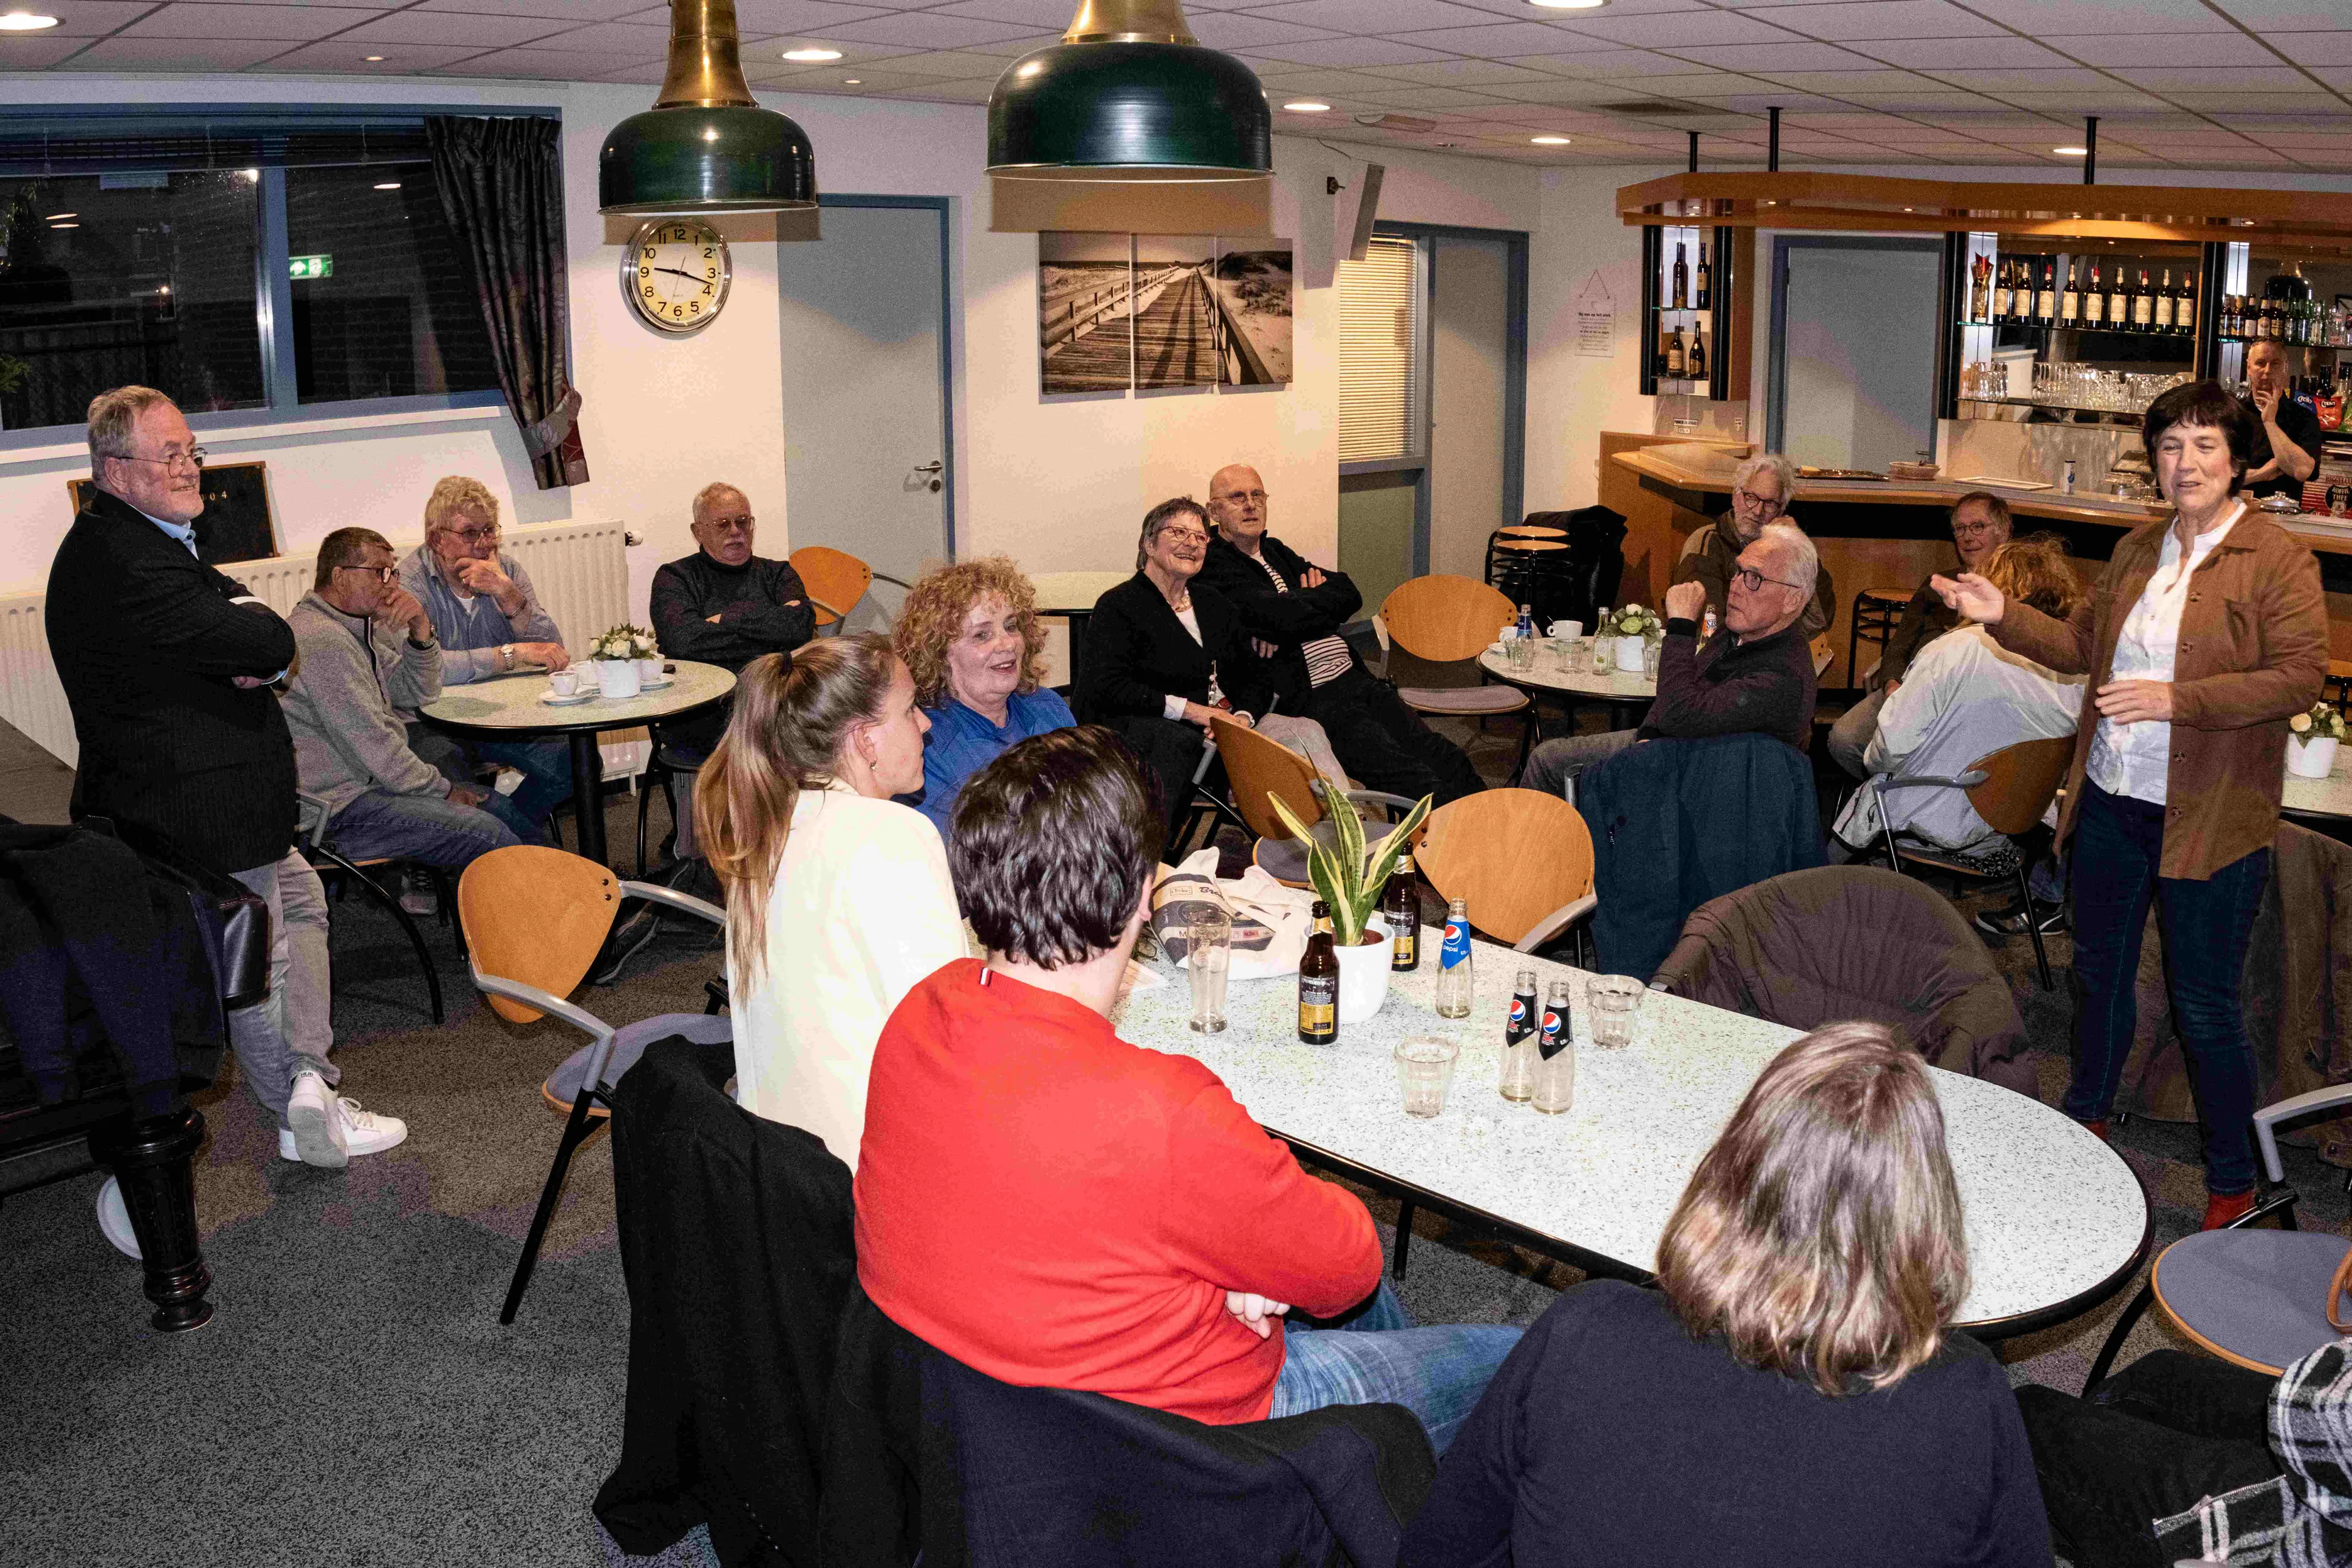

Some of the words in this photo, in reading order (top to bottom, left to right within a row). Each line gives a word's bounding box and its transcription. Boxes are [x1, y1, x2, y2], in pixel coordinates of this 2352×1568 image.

[658, 230, 666, 244] 11
[674, 228, 685, 240] 12
[695, 235, 698, 245] 1
[644, 247, 655, 259] 10
[704, 247, 712, 258] 2
[640, 267, 649, 277] 9
[707, 268, 716, 279] 3
[644, 286, 654, 298] 8
[703, 285, 711, 296] 4
[658, 301, 667, 312] 7
[674, 306, 682, 317] 6
[690, 301, 699, 312] 5
